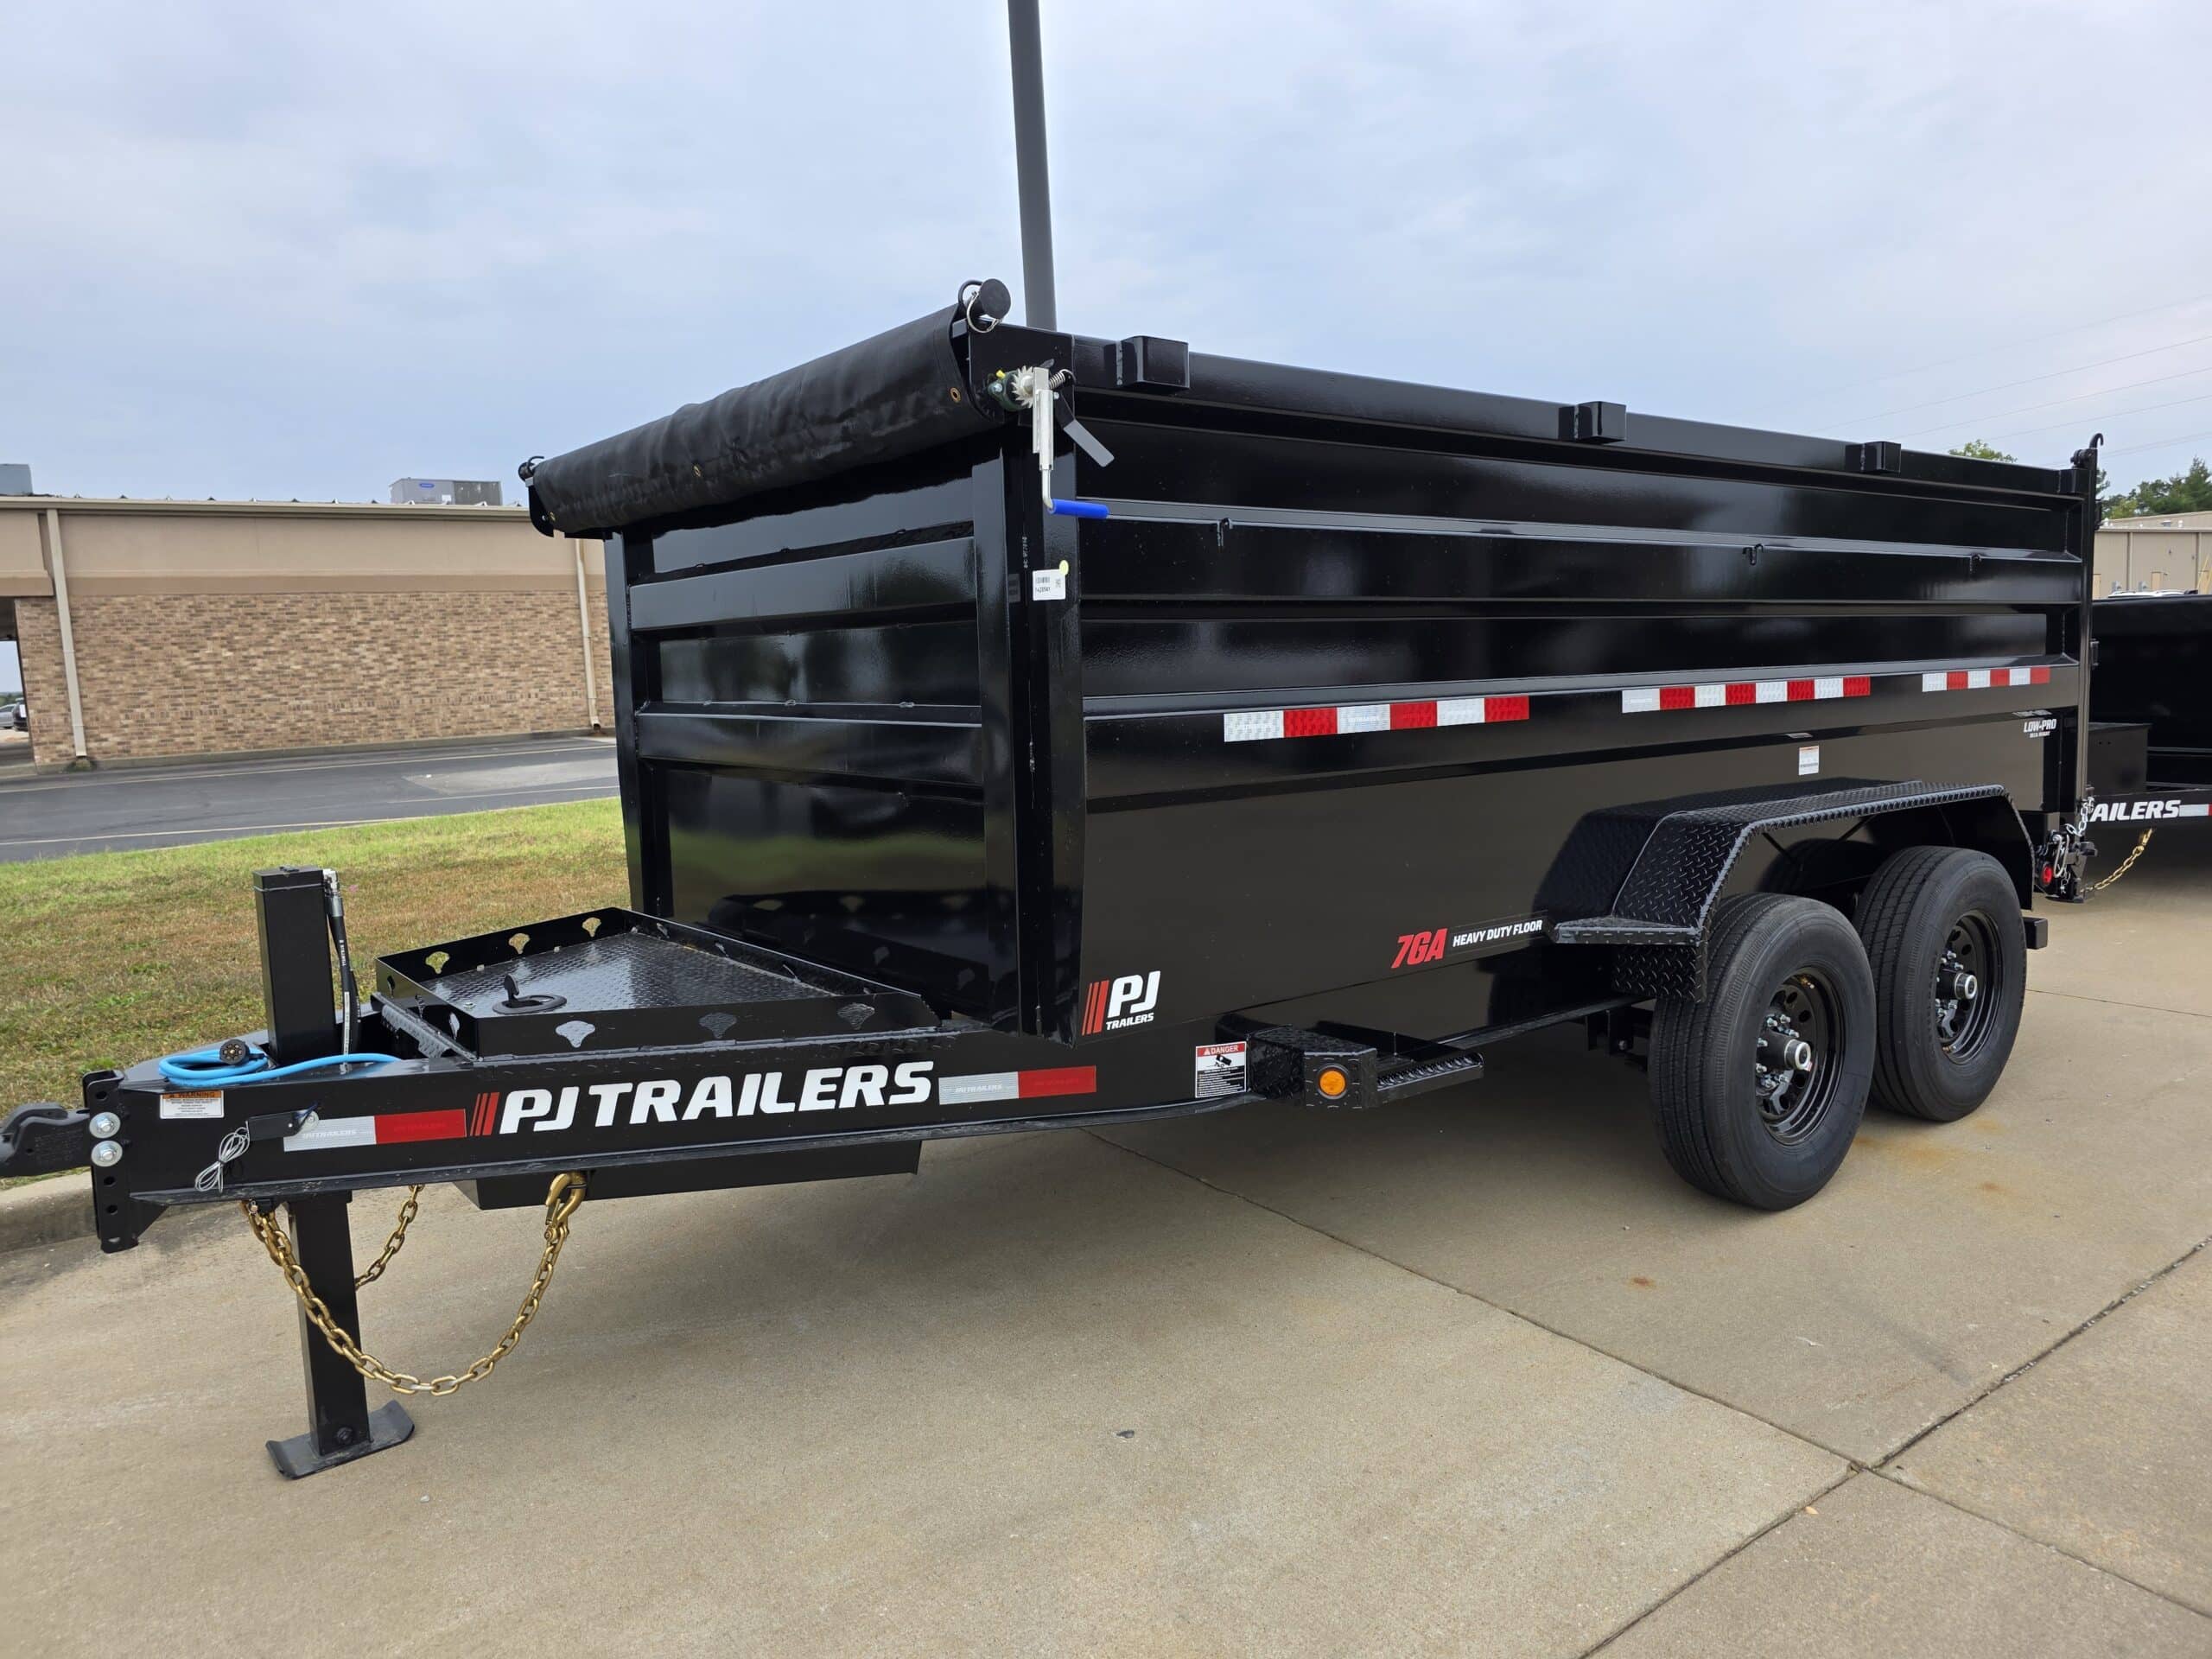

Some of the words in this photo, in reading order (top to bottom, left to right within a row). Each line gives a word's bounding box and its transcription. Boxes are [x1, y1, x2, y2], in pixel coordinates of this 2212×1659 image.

[2024, 718, 2057, 733] LOW-PRO
[2089, 799, 2181, 823] AILERS
[1391, 928, 1448, 969] 7GA
[1452, 929, 1487, 948] HEAVY
[1486, 925, 1513, 941] DUTY
[1513, 919, 1543, 936] FLOOR
[1107, 970, 1161, 1019] PJ
[1105, 1012, 1154, 1031] TRAILERS
[1211, 1045, 1239, 1055] DANGER
